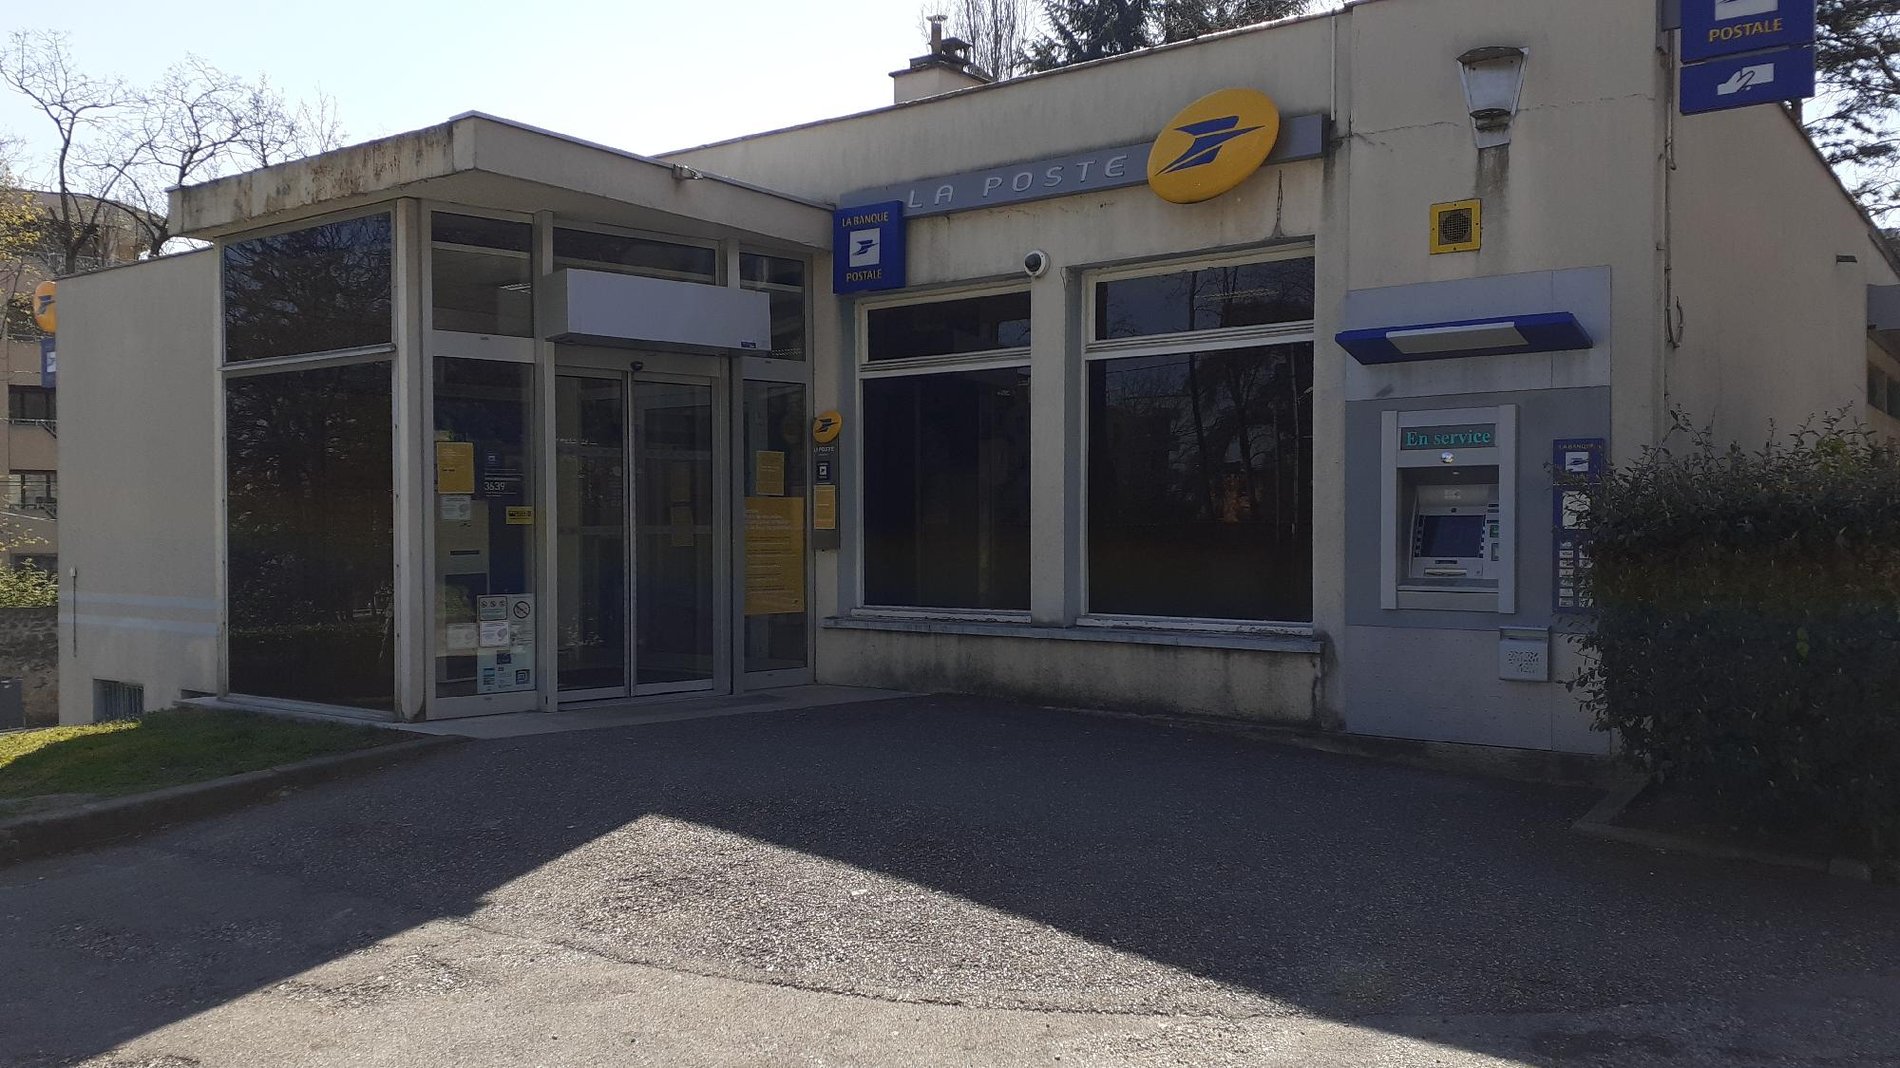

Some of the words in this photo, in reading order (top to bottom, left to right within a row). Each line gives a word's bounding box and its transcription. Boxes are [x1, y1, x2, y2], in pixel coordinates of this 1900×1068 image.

[1708, 17, 1784, 43] POSTALE
[907, 184, 955, 209] LA
[983, 154, 1129, 198] POSTE
[842, 217, 852, 227] LA
[853, 211, 889, 225] BANQUE
[846, 269, 883, 282] POSTALE
[1406, 431, 1428, 446] En
[1434, 429, 1491, 445] service
